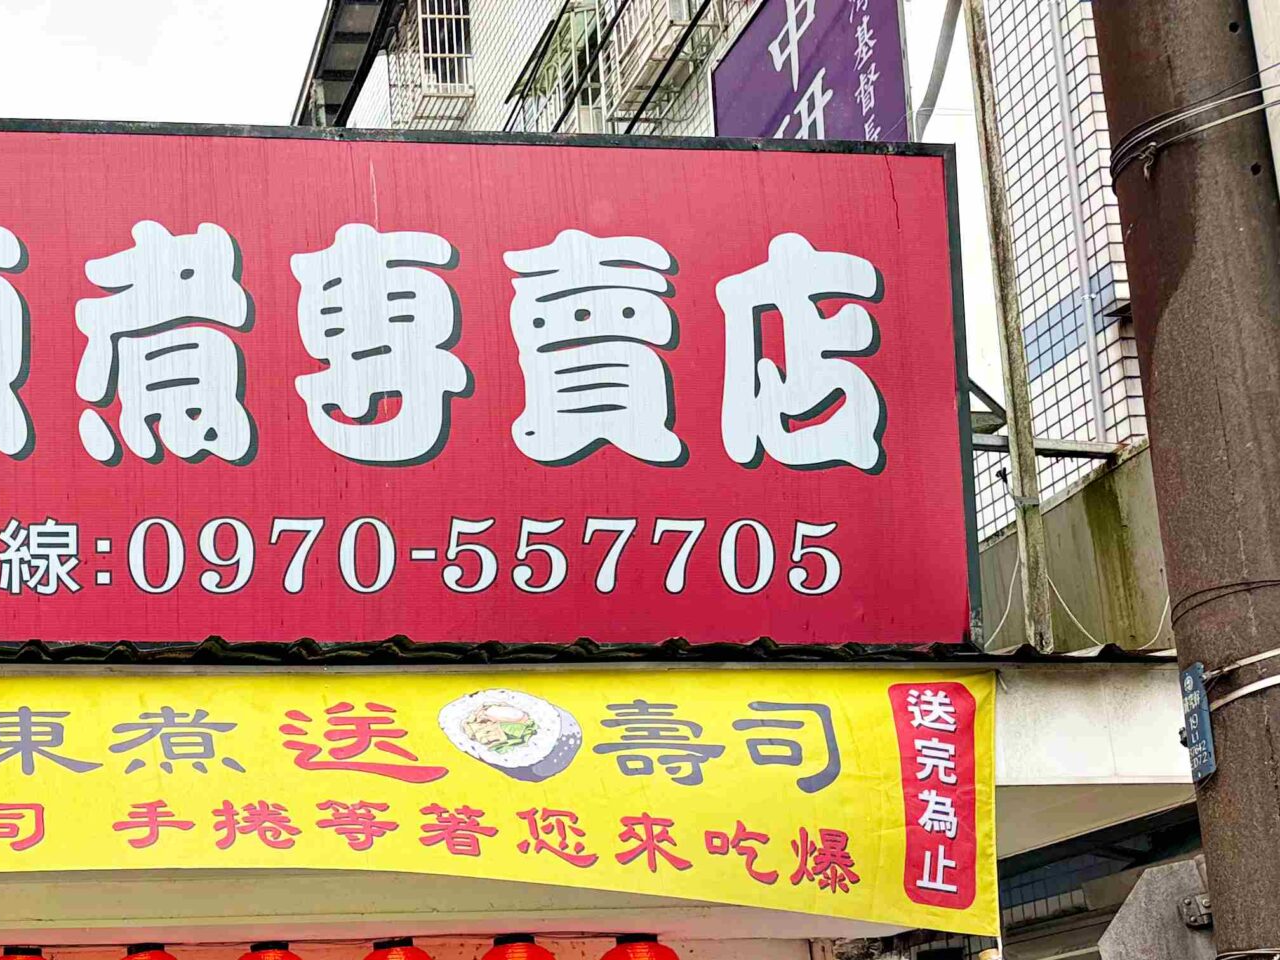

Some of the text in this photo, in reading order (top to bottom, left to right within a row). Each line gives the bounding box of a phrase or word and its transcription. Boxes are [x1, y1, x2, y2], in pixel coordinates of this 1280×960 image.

[592, 699, 842, 795] 壽司
[906, 689, 959, 896] 送完為止
